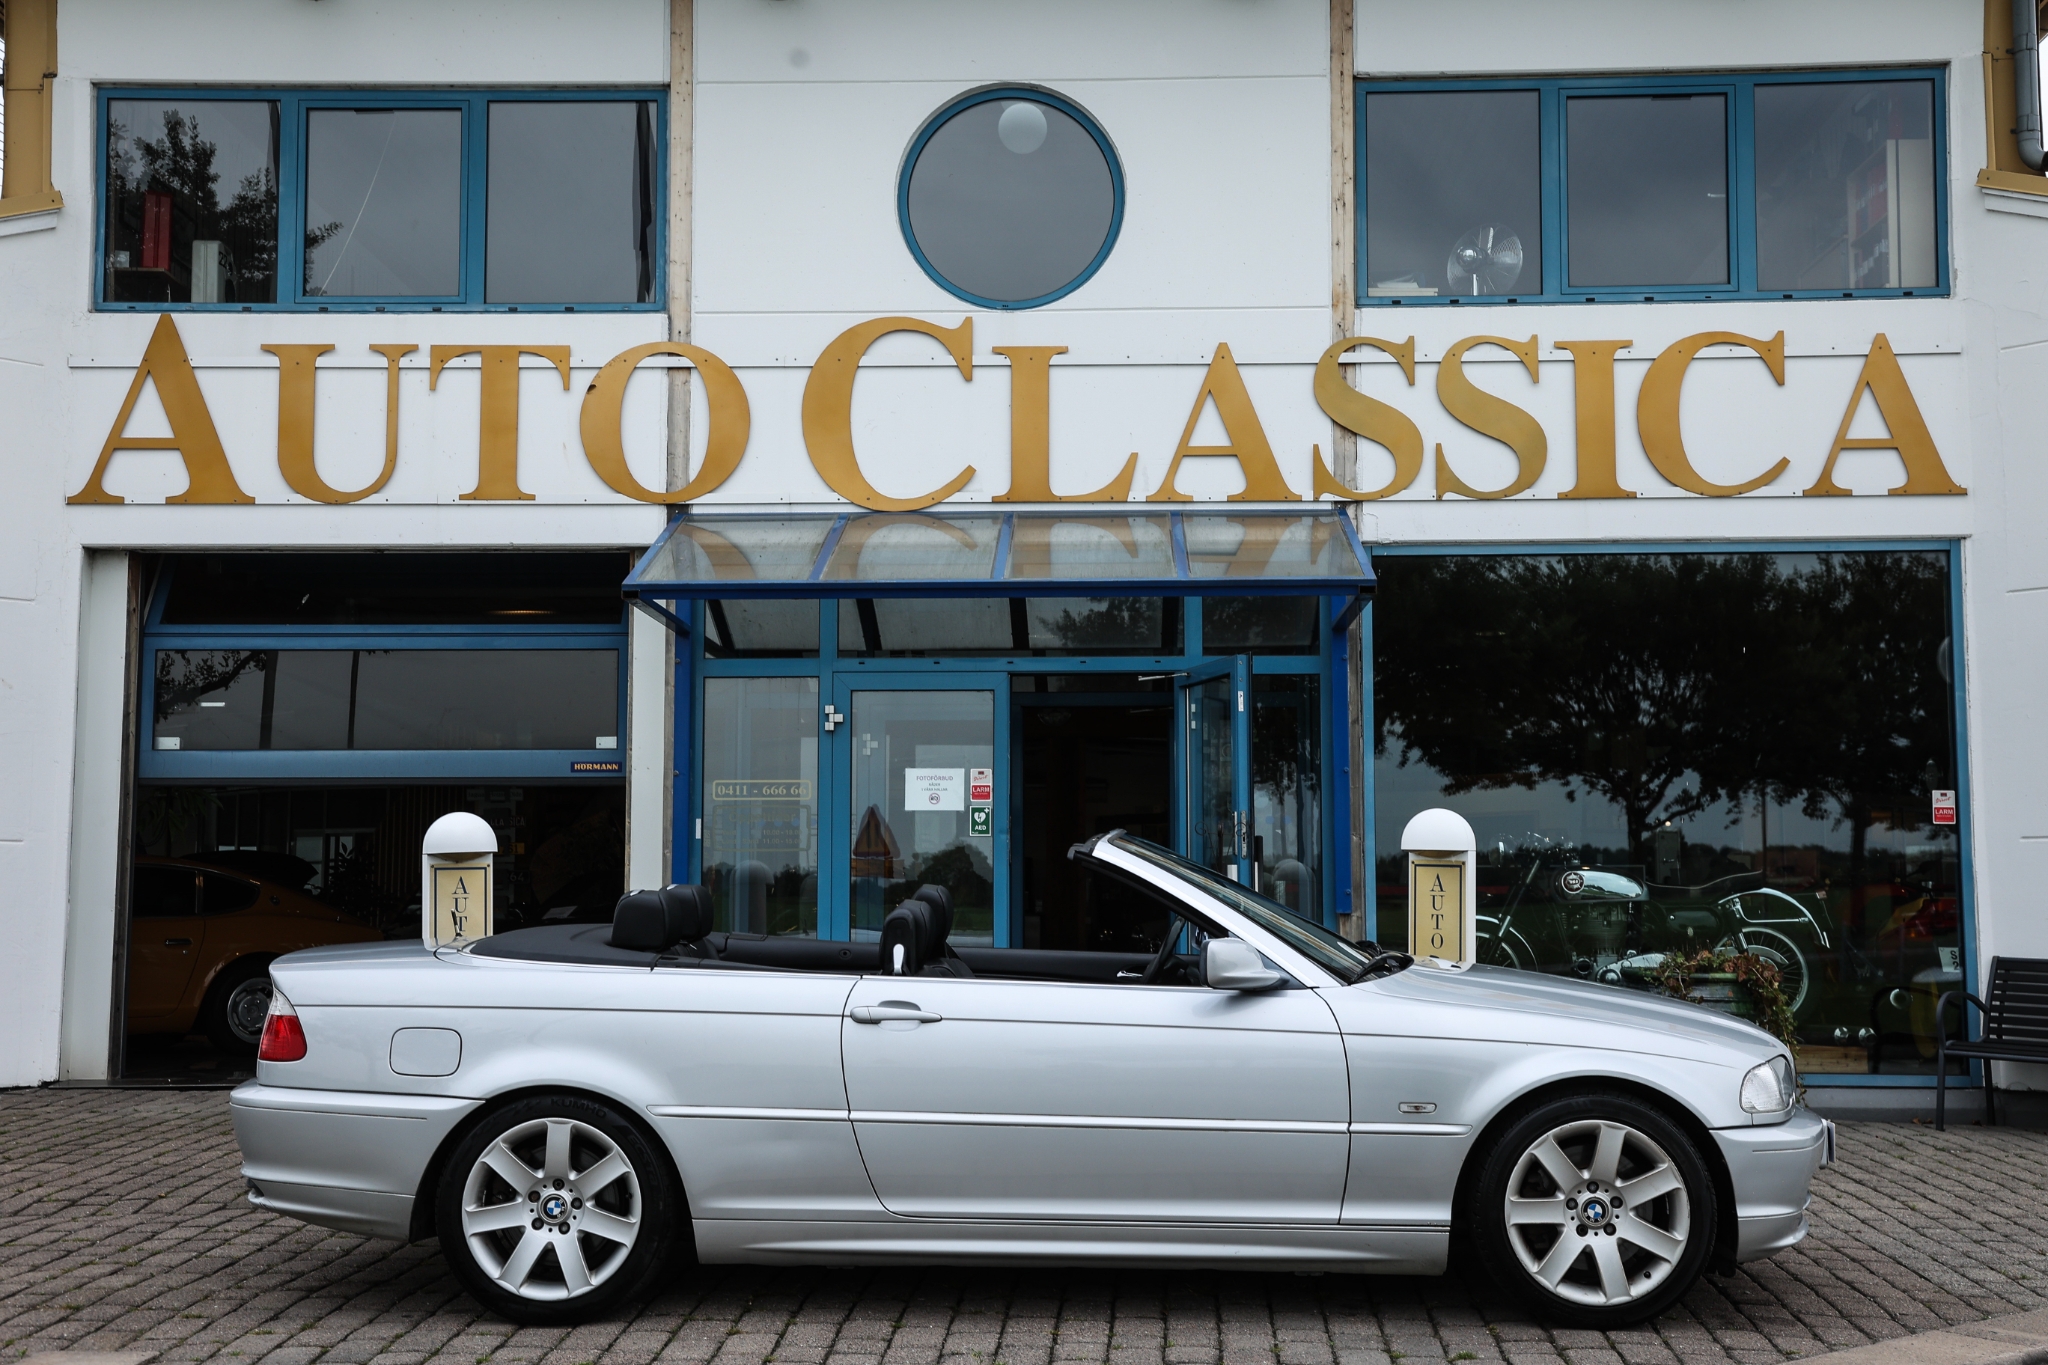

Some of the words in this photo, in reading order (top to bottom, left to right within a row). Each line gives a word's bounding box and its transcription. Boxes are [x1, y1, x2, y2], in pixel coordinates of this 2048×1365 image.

[66, 312, 750, 505] AUTO
[801, 315, 1968, 513] CLASSICA
[717, 785, 748, 795] 0411
[762, 785, 787, 795] 666
[790, 785, 807, 795] 66
[1429, 872, 1446, 950] AUTO
[550, 1097, 607, 1119] KUMHO
